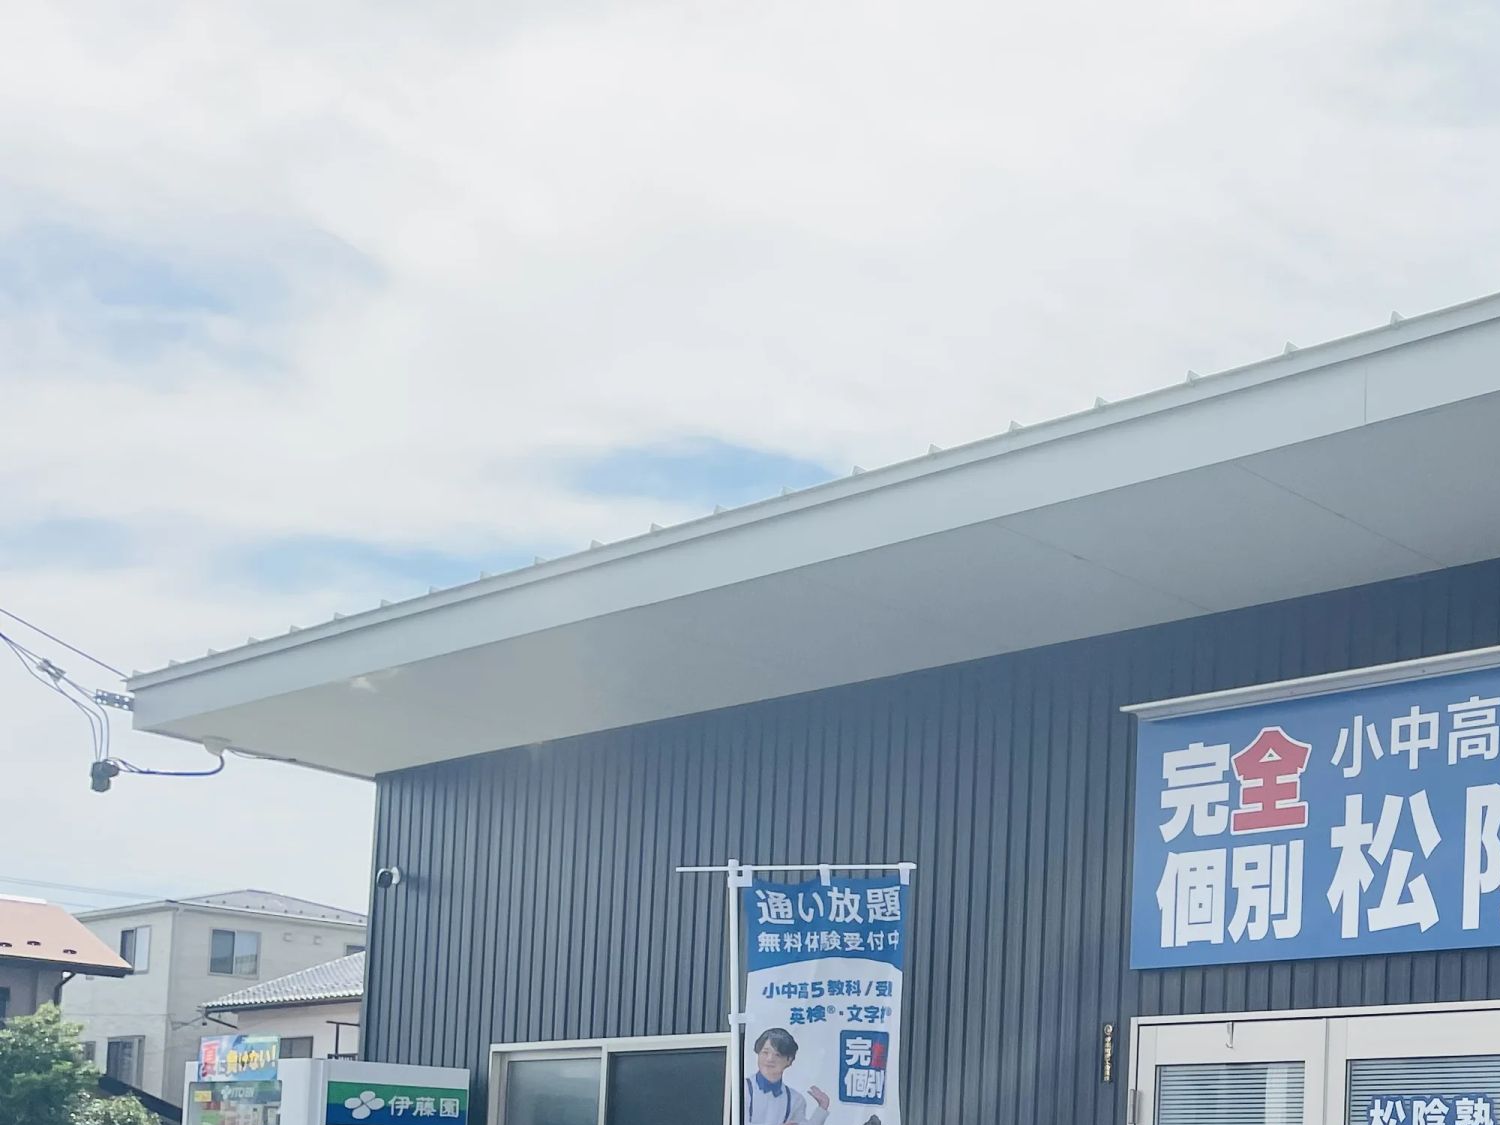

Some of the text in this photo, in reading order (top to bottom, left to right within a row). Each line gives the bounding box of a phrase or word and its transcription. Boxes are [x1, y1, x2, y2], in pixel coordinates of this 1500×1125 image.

[1159, 726, 1312, 842] 完全
[756, 886, 901, 925] 通い放題
[1156, 839, 1304, 948] 個別
[844, 1068, 885, 1098] 個別
[388, 1095, 459, 1118] 伊藤園
